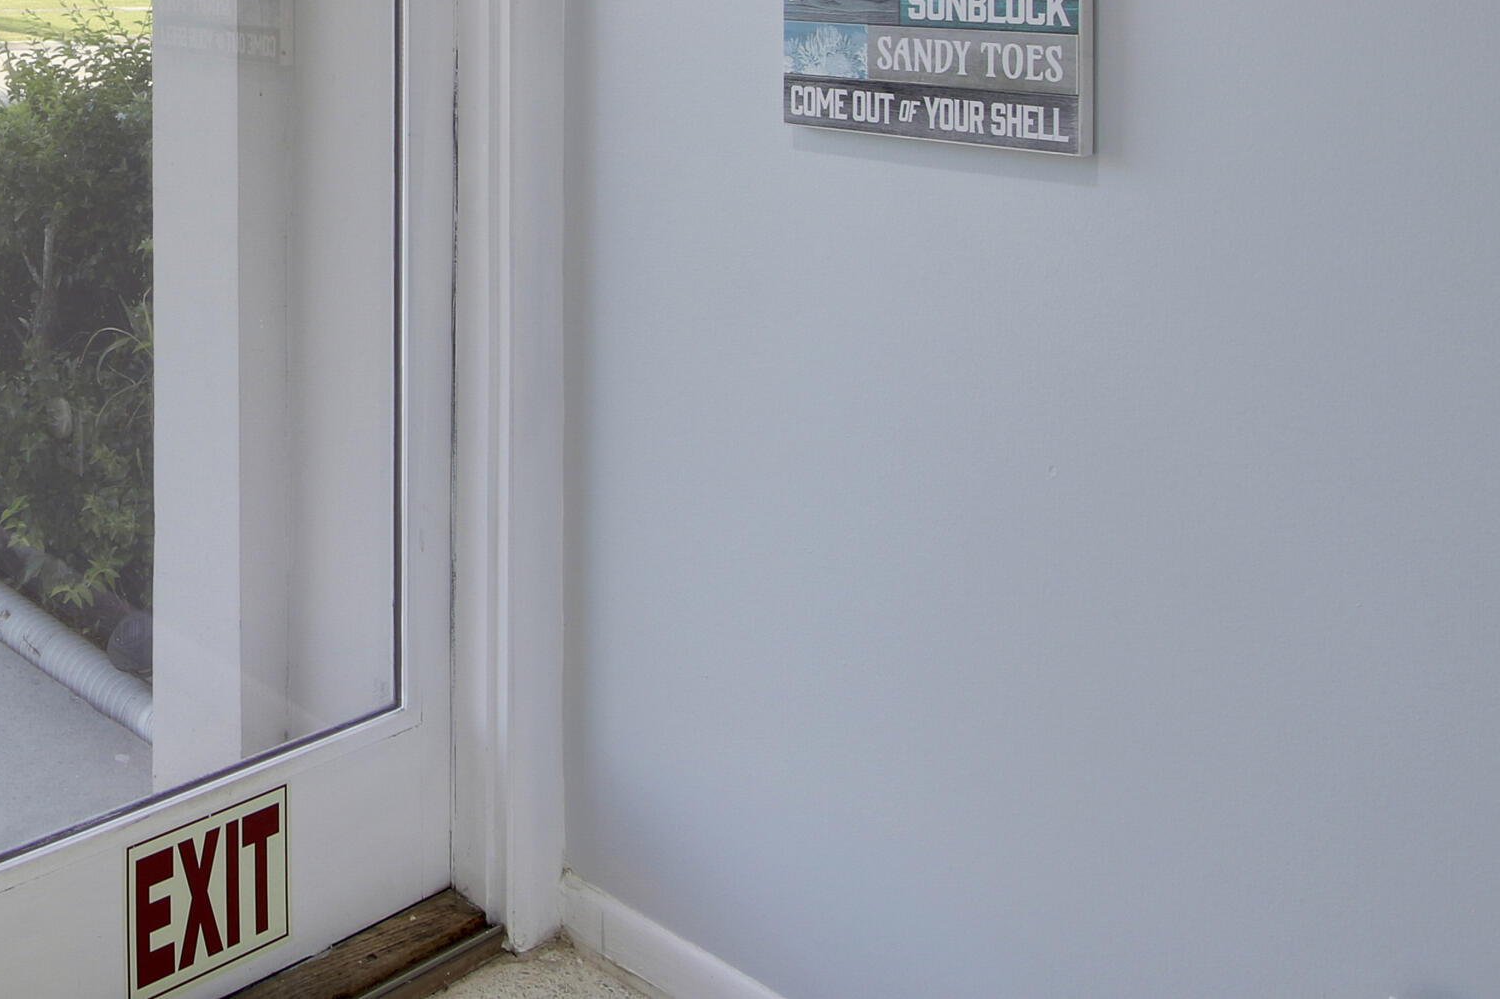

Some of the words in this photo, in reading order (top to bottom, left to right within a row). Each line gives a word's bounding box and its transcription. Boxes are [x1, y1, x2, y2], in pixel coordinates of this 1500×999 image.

[877, 35, 972, 77] SANDY
[980, 42, 1063, 83] TOES
[790, 85, 848, 120] COME
[852, 90, 896, 125] OUT
[899, 99, 921, 123] OF
[923, 96, 985, 134] YOUR
[990, 102, 1070, 143] SHELL
[136, 803, 279, 989] EXIT
